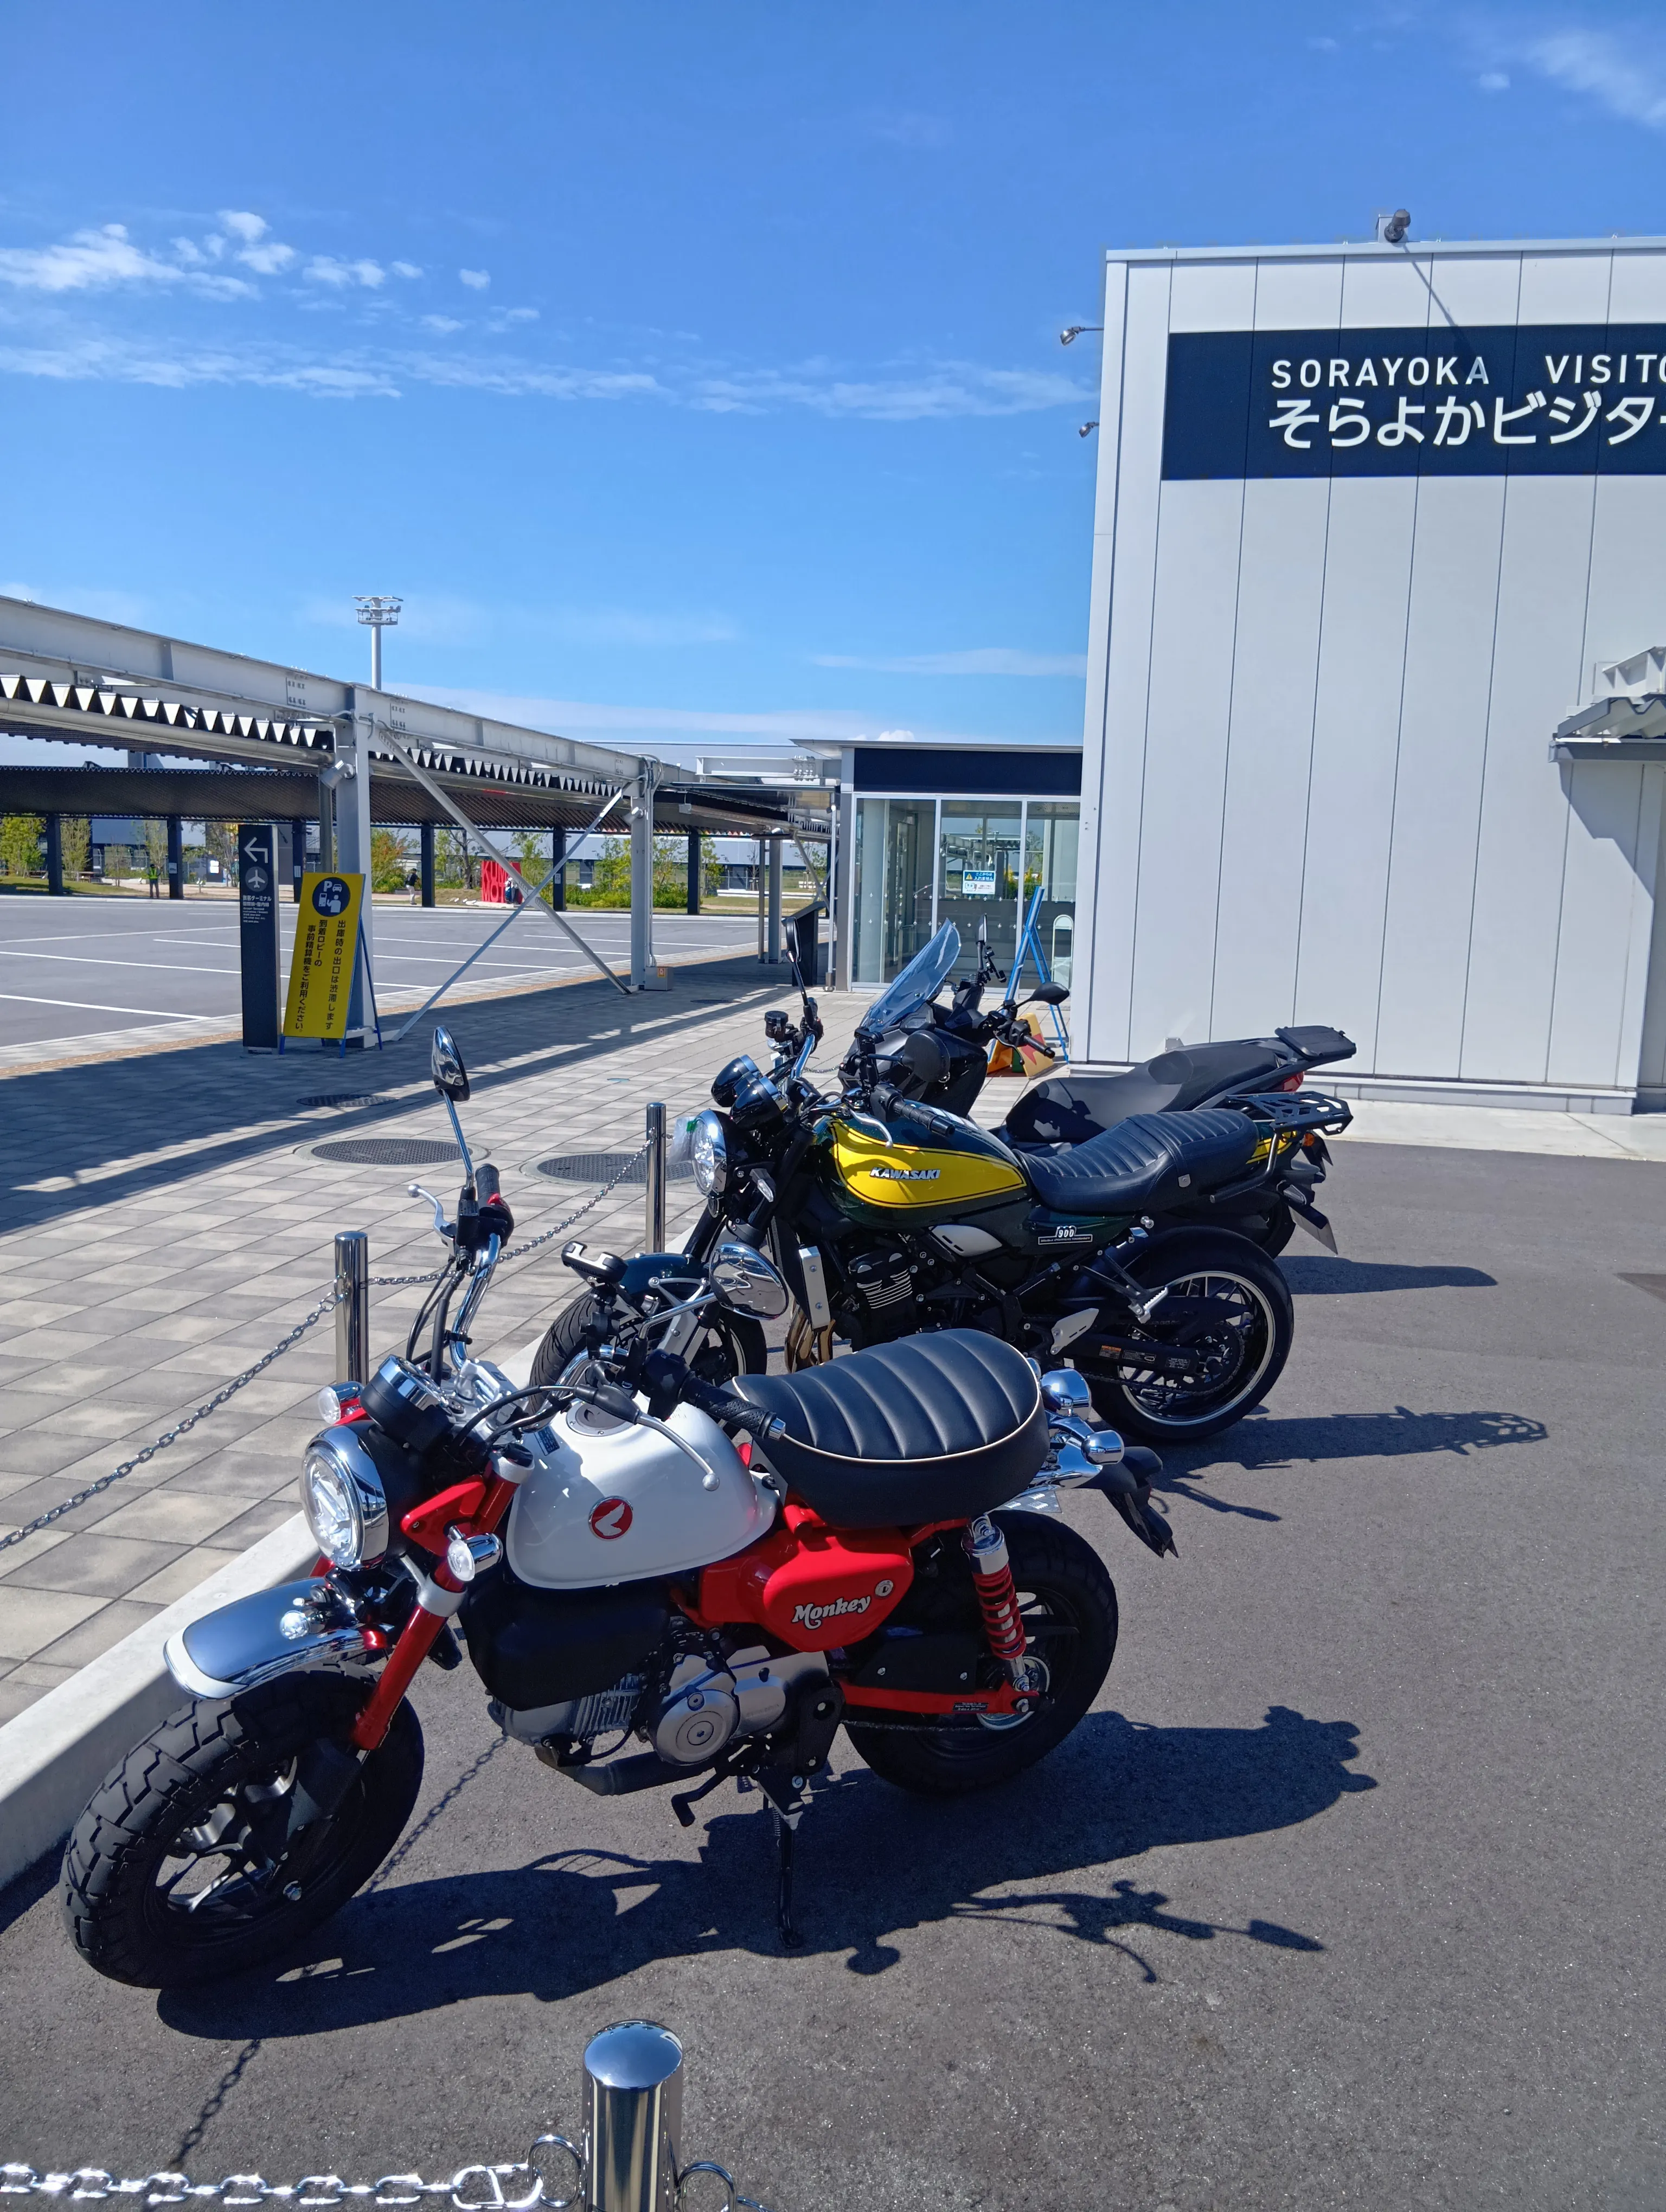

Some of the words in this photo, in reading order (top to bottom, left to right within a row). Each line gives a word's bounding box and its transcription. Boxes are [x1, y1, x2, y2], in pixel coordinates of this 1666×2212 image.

[1272, 356, 1489, 388] SORAYOKA
[1269, 390, 1666, 449] そらよかビジタ
[869, 1167, 941, 1180] KAWASAKI
[1058, 1229, 1074, 1238] 900
[792, 1596, 871, 1629] Monkey
